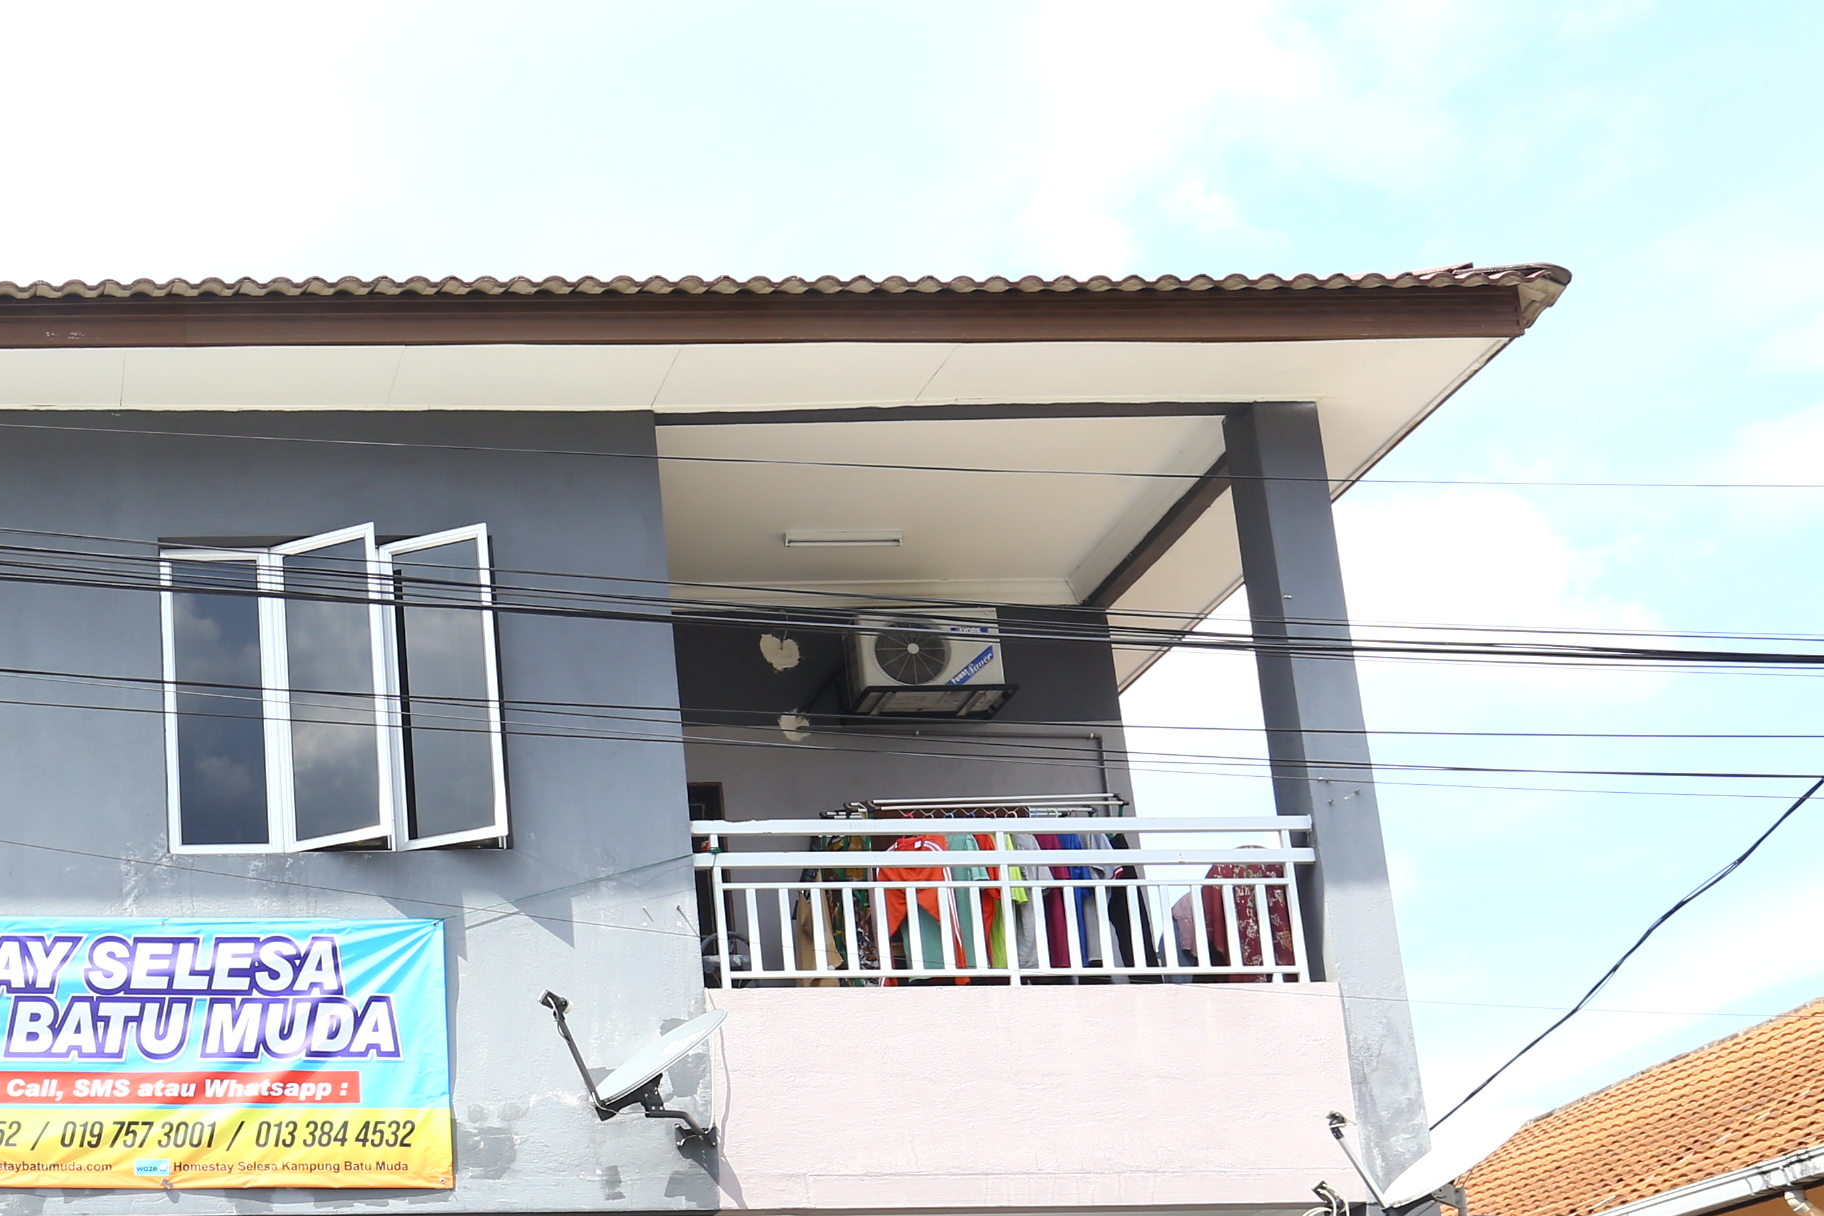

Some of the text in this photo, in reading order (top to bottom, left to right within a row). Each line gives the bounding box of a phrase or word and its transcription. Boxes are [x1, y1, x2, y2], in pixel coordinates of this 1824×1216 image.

[84, 936, 344, 996] SELESA
[4, 995, 191, 1060] BATU
[200, 996, 401, 1060] MUDA
[6, 1078, 64, 1102] Call,
[72, 1078, 131, 1099] SMS
[137, 1080, 196, 1099] atau
[204, 1078, 333, 1101] Whatsapp
[60, 1120, 104, 1149] 019
[109, 1120, 155, 1149] 757
[157, 1120, 218, 1149] 3001
[255, 1119, 298, 1149] 013
[302, 1120, 350, 1148] 384
[354, 1119, 416, 1148] 4532
[173, 1161, 234, 1174] Homestay
[237, 1161, 278, 1172] Selesa
[282, 1161, 341, 1174] Kampung
[344, 1161, 372, 1172] Batu
[375, 1161, 409, 1172] Muda
